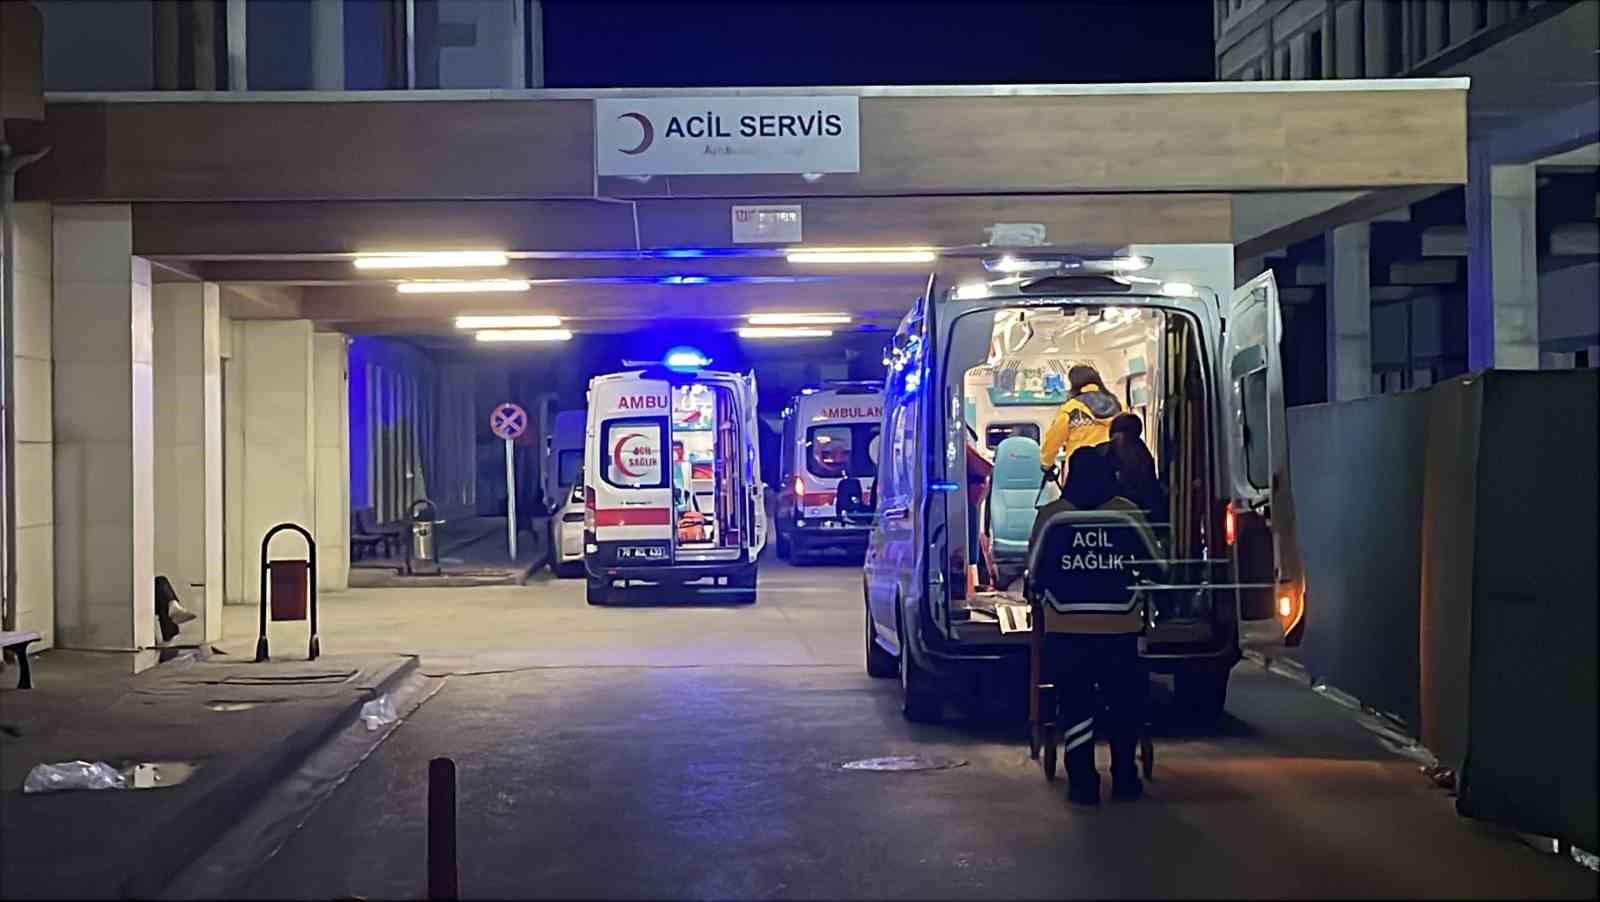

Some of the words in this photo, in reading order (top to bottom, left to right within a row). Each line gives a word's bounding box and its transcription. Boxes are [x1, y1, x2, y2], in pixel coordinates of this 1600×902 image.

[665, 111, 731, 138] ACİL
[739, 110, 842, 137] SERVİS
[618, 395, 668, 409] AMBU
[1073, 528, 1113, 547] ACİL
[1062, 550, 1124, 570] SAĞLIK
